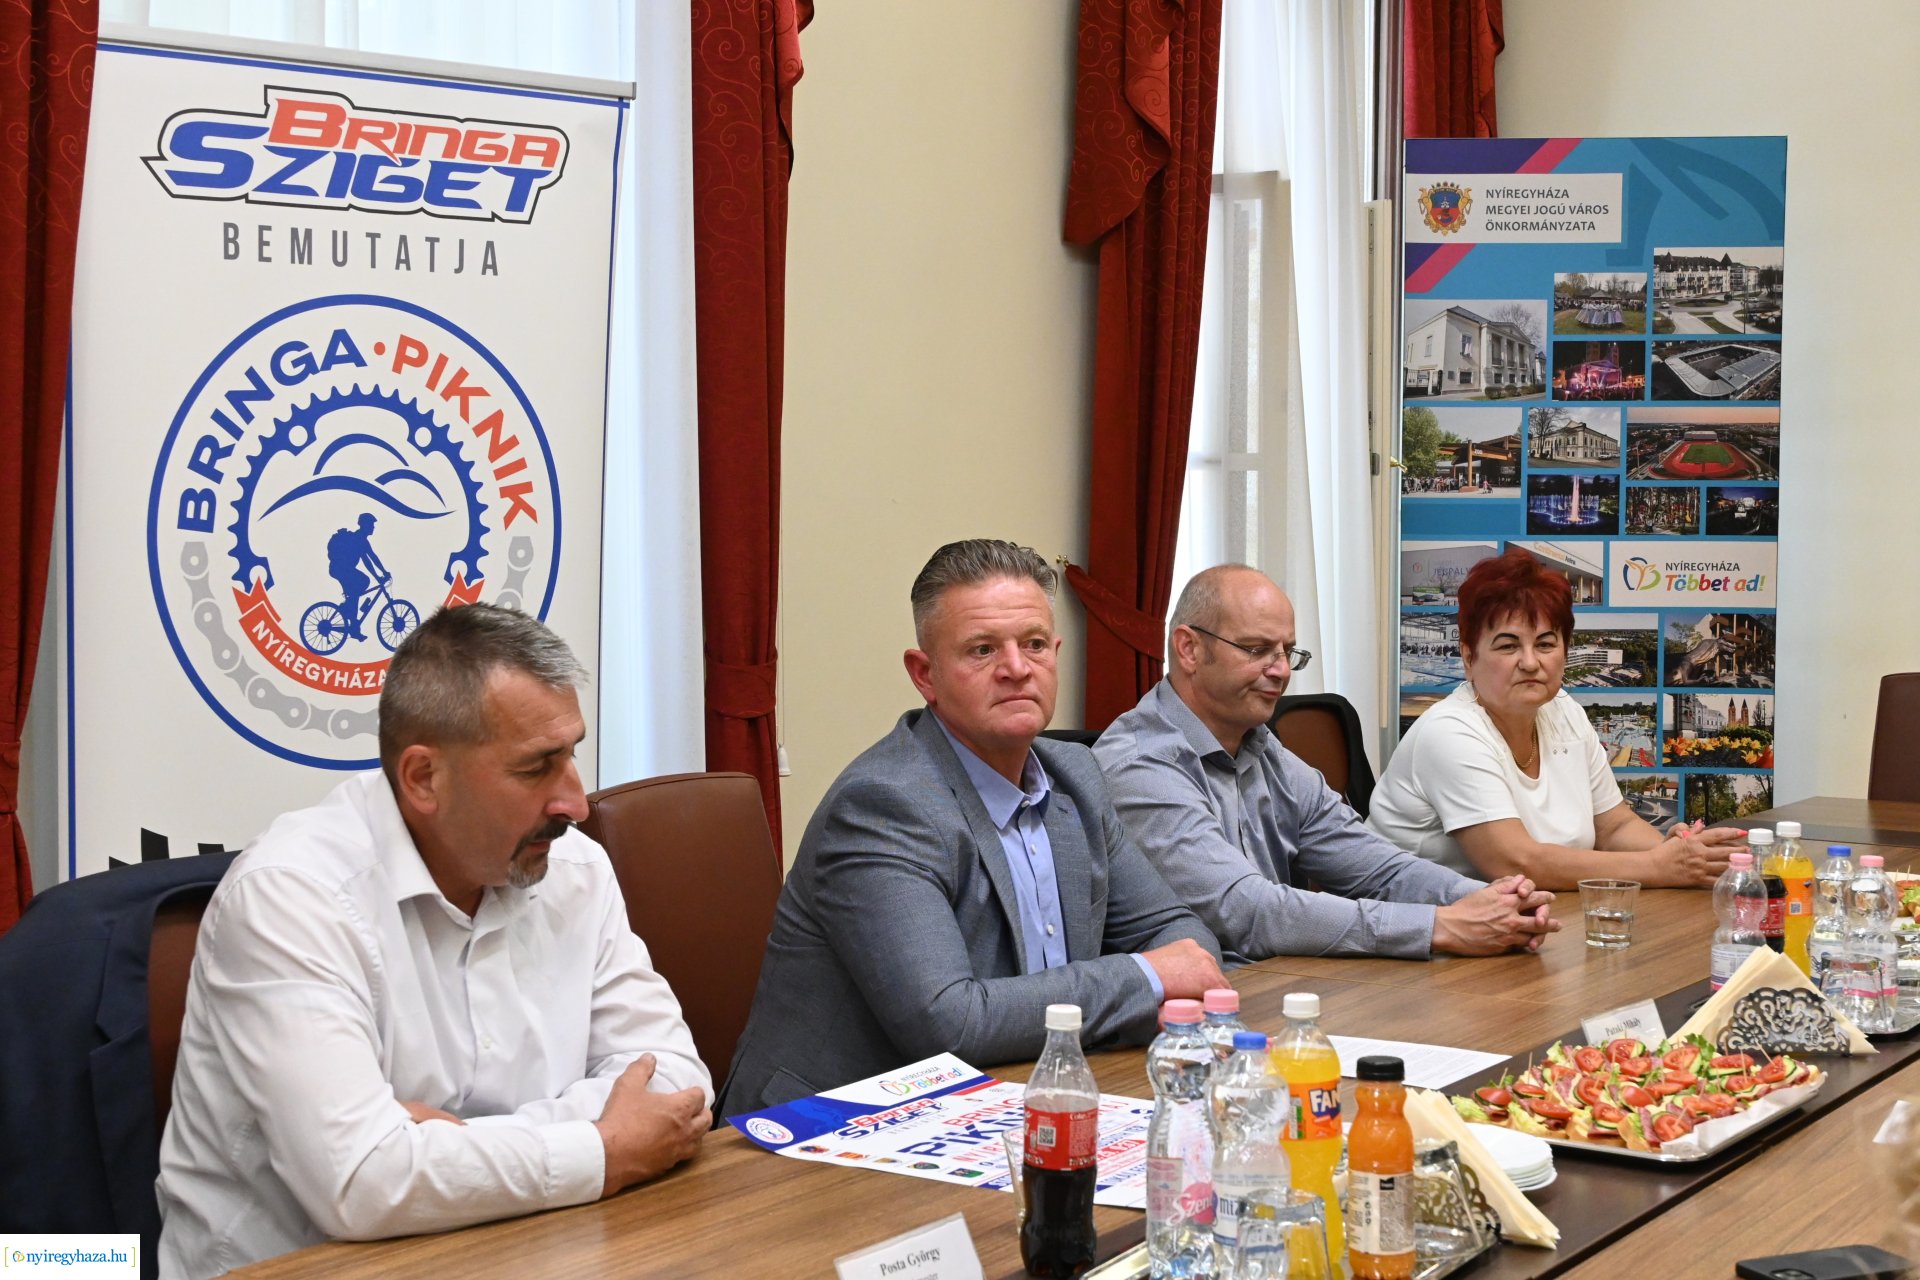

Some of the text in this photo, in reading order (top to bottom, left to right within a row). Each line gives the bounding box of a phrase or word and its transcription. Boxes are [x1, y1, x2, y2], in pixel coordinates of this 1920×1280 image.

[268, 98, 561, 167] BRINGA
[164, 120, 553, 213] SZIGET
[1485, 187, 1570, 199] NYÍREGYHÁZA
[1485, 203, 1609, 215] MEGYEI JOGÚ VÁROS
[1485, 219, 1596, 231] ÖNKORMÁNYZATA
[222, 221, 499, 277] BEMUTATJA
[177, 328, 539, 534] BRINGA PIKNIK
[1665, 560, 1740, 571] NYÍREGYHÁZA
[1665, 573, 1766, 592] Többet ad!
[944, 1097, 1025, 1126] BRING
[880, 1258, 907, 1276] Posta
[906, 1247, 941, 1268] György
